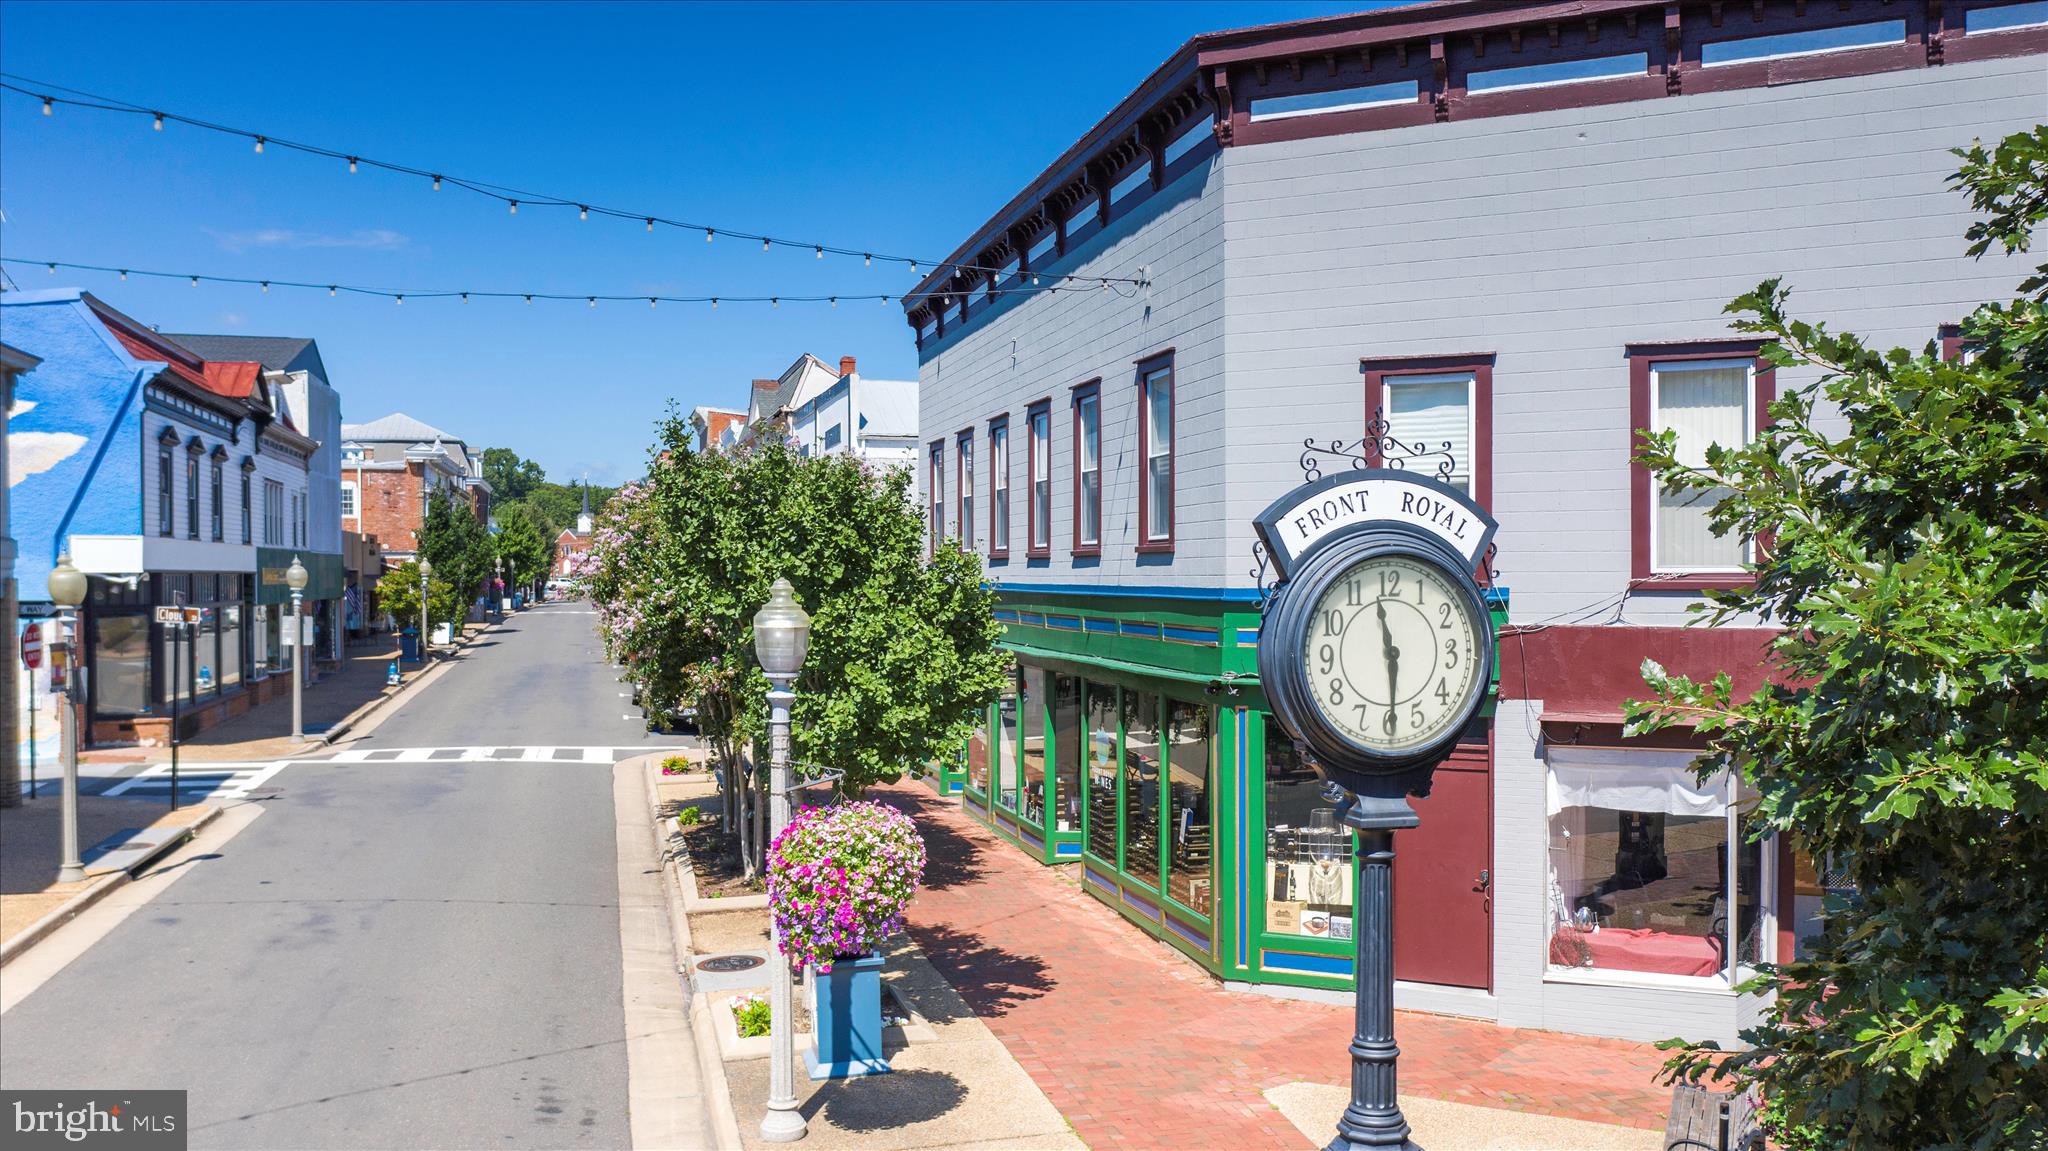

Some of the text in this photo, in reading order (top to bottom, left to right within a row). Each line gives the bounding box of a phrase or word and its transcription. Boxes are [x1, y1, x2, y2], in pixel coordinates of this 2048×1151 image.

[1294, 490, 1468, 540] FRONT ROYAL
[1345, 579, 1363, 606] 11
[1378, 570, 1401, 598] 12
[1415, 579, 1425, 605] 1
[1322, 608, 1344, 637] 10
[1439, 602, 1453, 629] 2
[1319, 644, 1334, 675] 9
[1445, 638, 1459, 669] 3
[1329, 678, 1344, 706] 8
[1434, 676, 1450, 706] 4
[1352, 703, 1370, 731] 7
[1382, 709, 1396, 736] 6
[1410, 699, 1425, 729] 5
